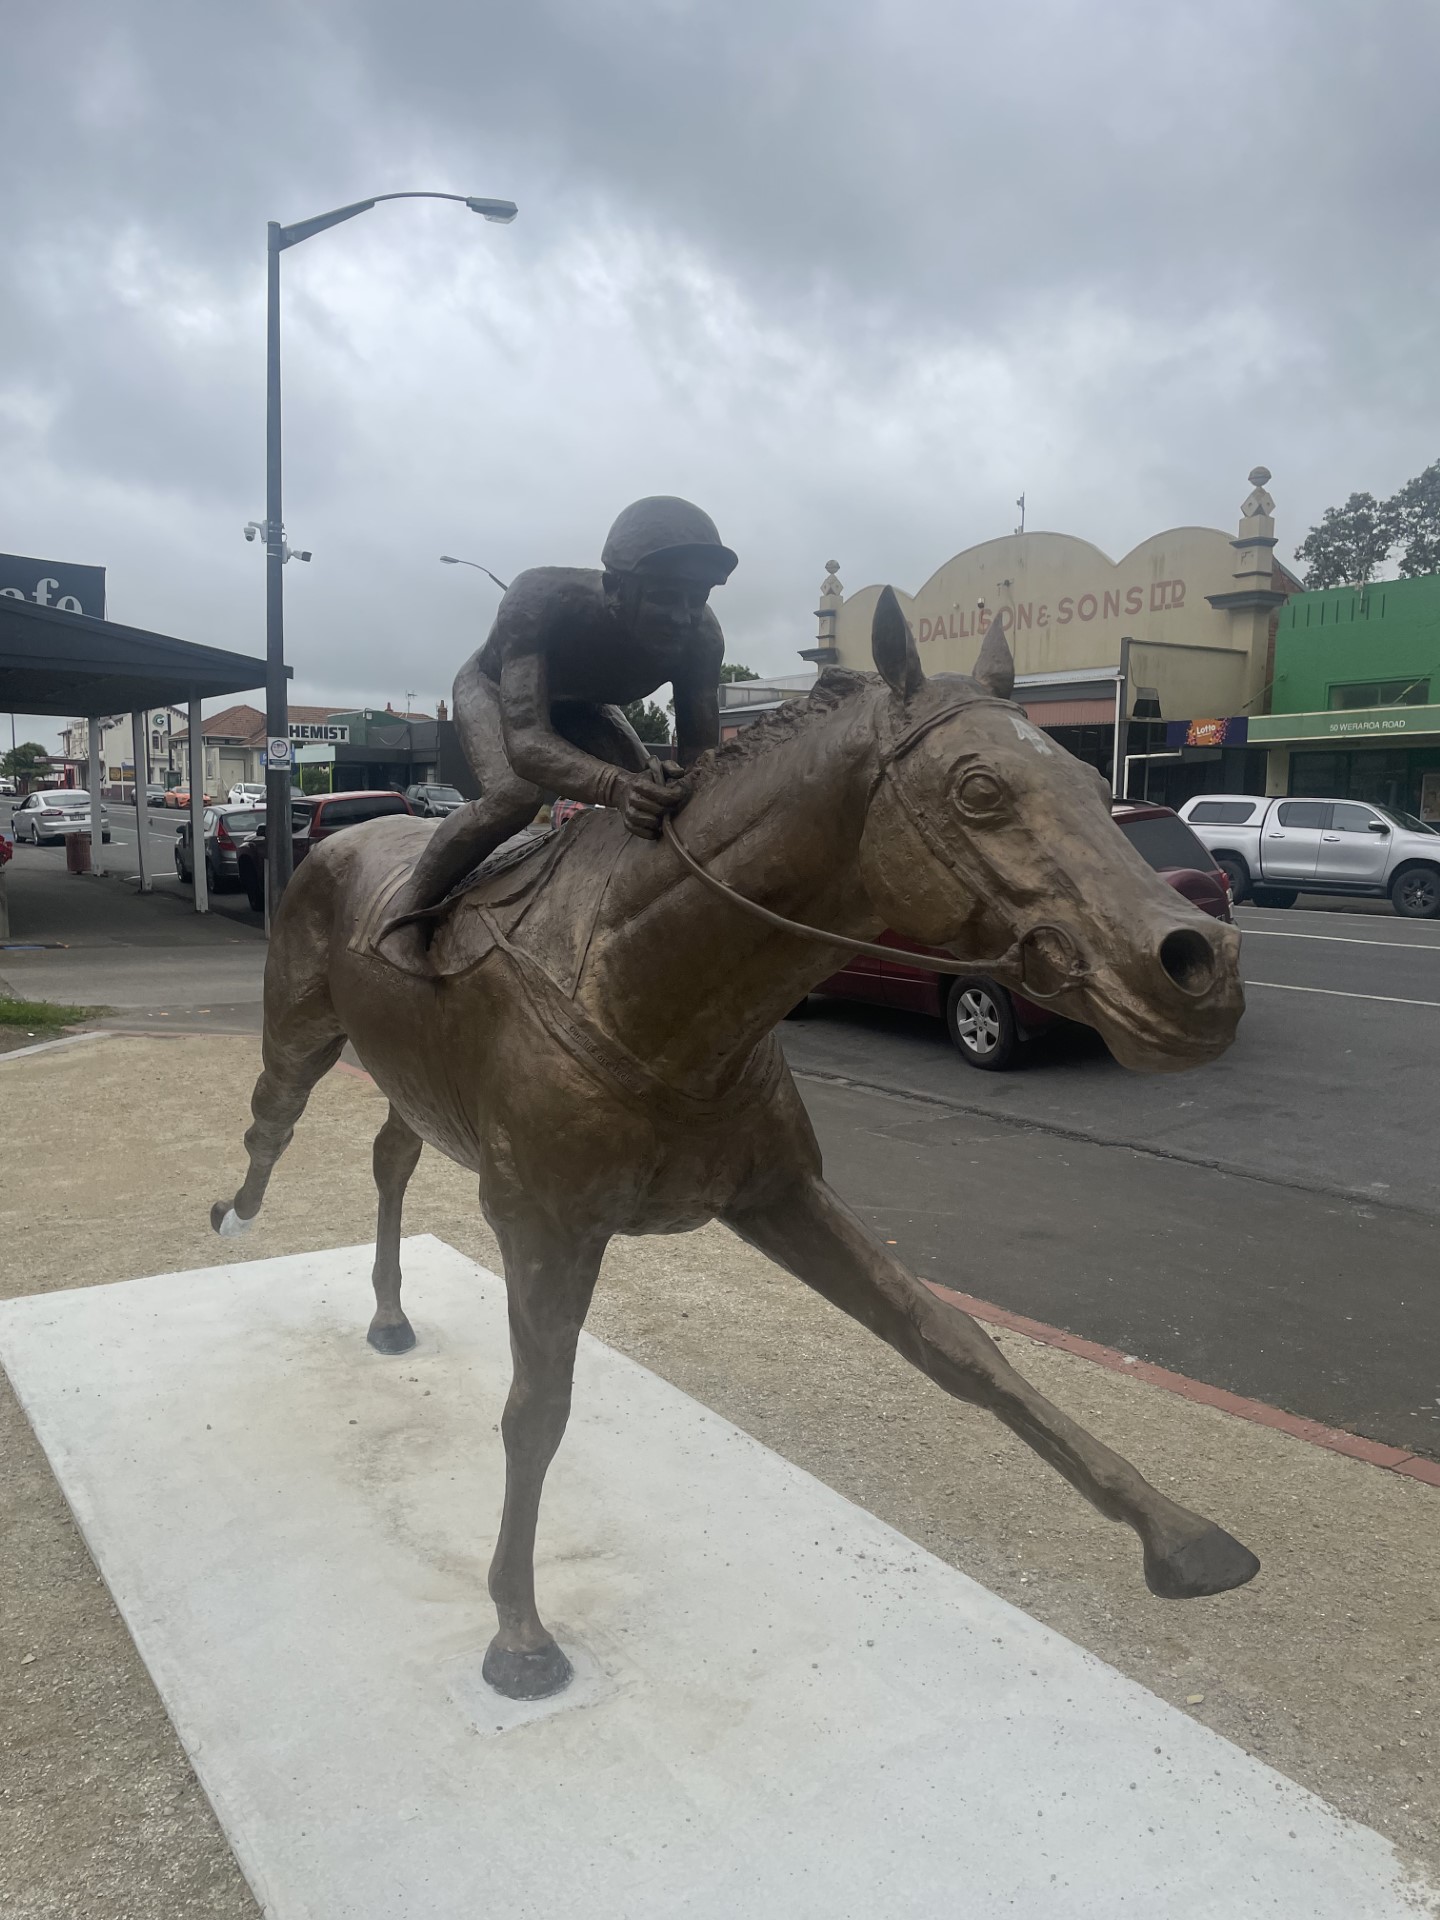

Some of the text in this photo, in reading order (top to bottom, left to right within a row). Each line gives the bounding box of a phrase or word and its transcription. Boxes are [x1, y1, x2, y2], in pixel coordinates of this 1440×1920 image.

[919, 602, 1032, 643] DALLISON
[1037, 605, 1051, 627] &
[1056, 586, 1143, 625] SONS
[1150, 579, 1186, 612] LTD
[1196, 724, 1216, 735] Lotto
[1329, 720, 1406, 732] 50 WERAROA ROAD
